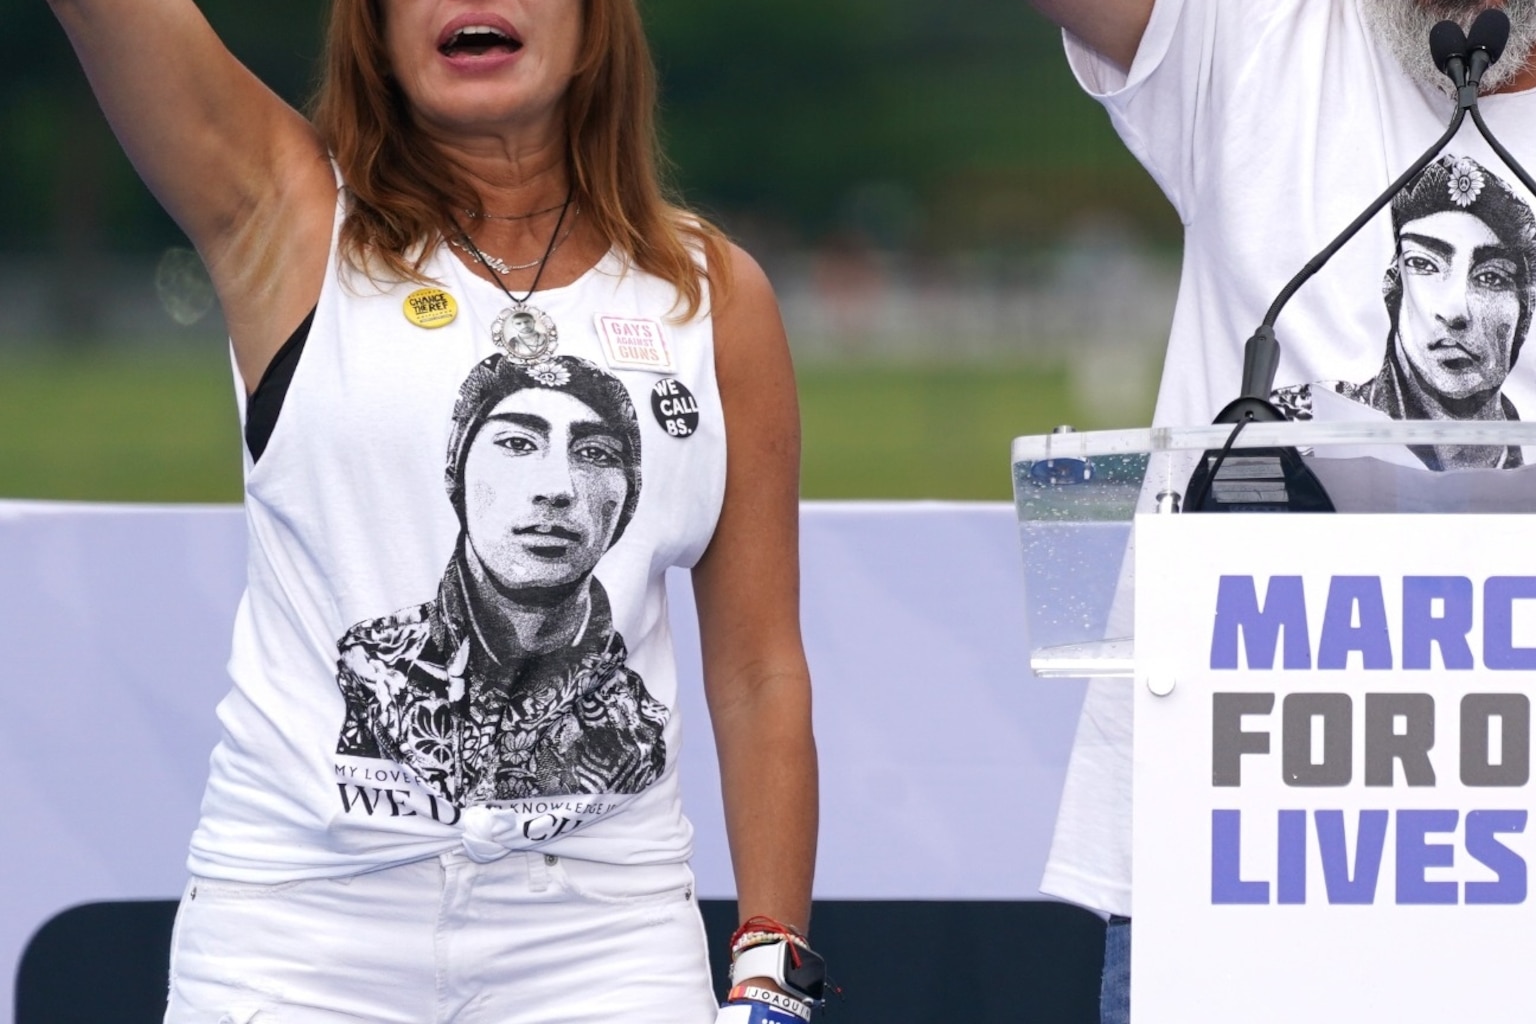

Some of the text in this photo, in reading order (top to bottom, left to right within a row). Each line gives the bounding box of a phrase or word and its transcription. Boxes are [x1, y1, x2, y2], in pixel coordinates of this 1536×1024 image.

[429, 299, 449, 312] REF
[611, 322, 653, 337] GAYS
[616, 337, 654, 347] AGAINST
[618, 345, 660, 361] GUNS
[653, 378, 679, 397] WE
[660, 396, 698, 416] CALL
[665, 418, 692, 436] BS.
[1211, 692, 1437, 787] FOR
[335, 764, 358, 777] MY
[337, 783, 418, 817] WE
[1210, 809, 1528, 905] LIVES
